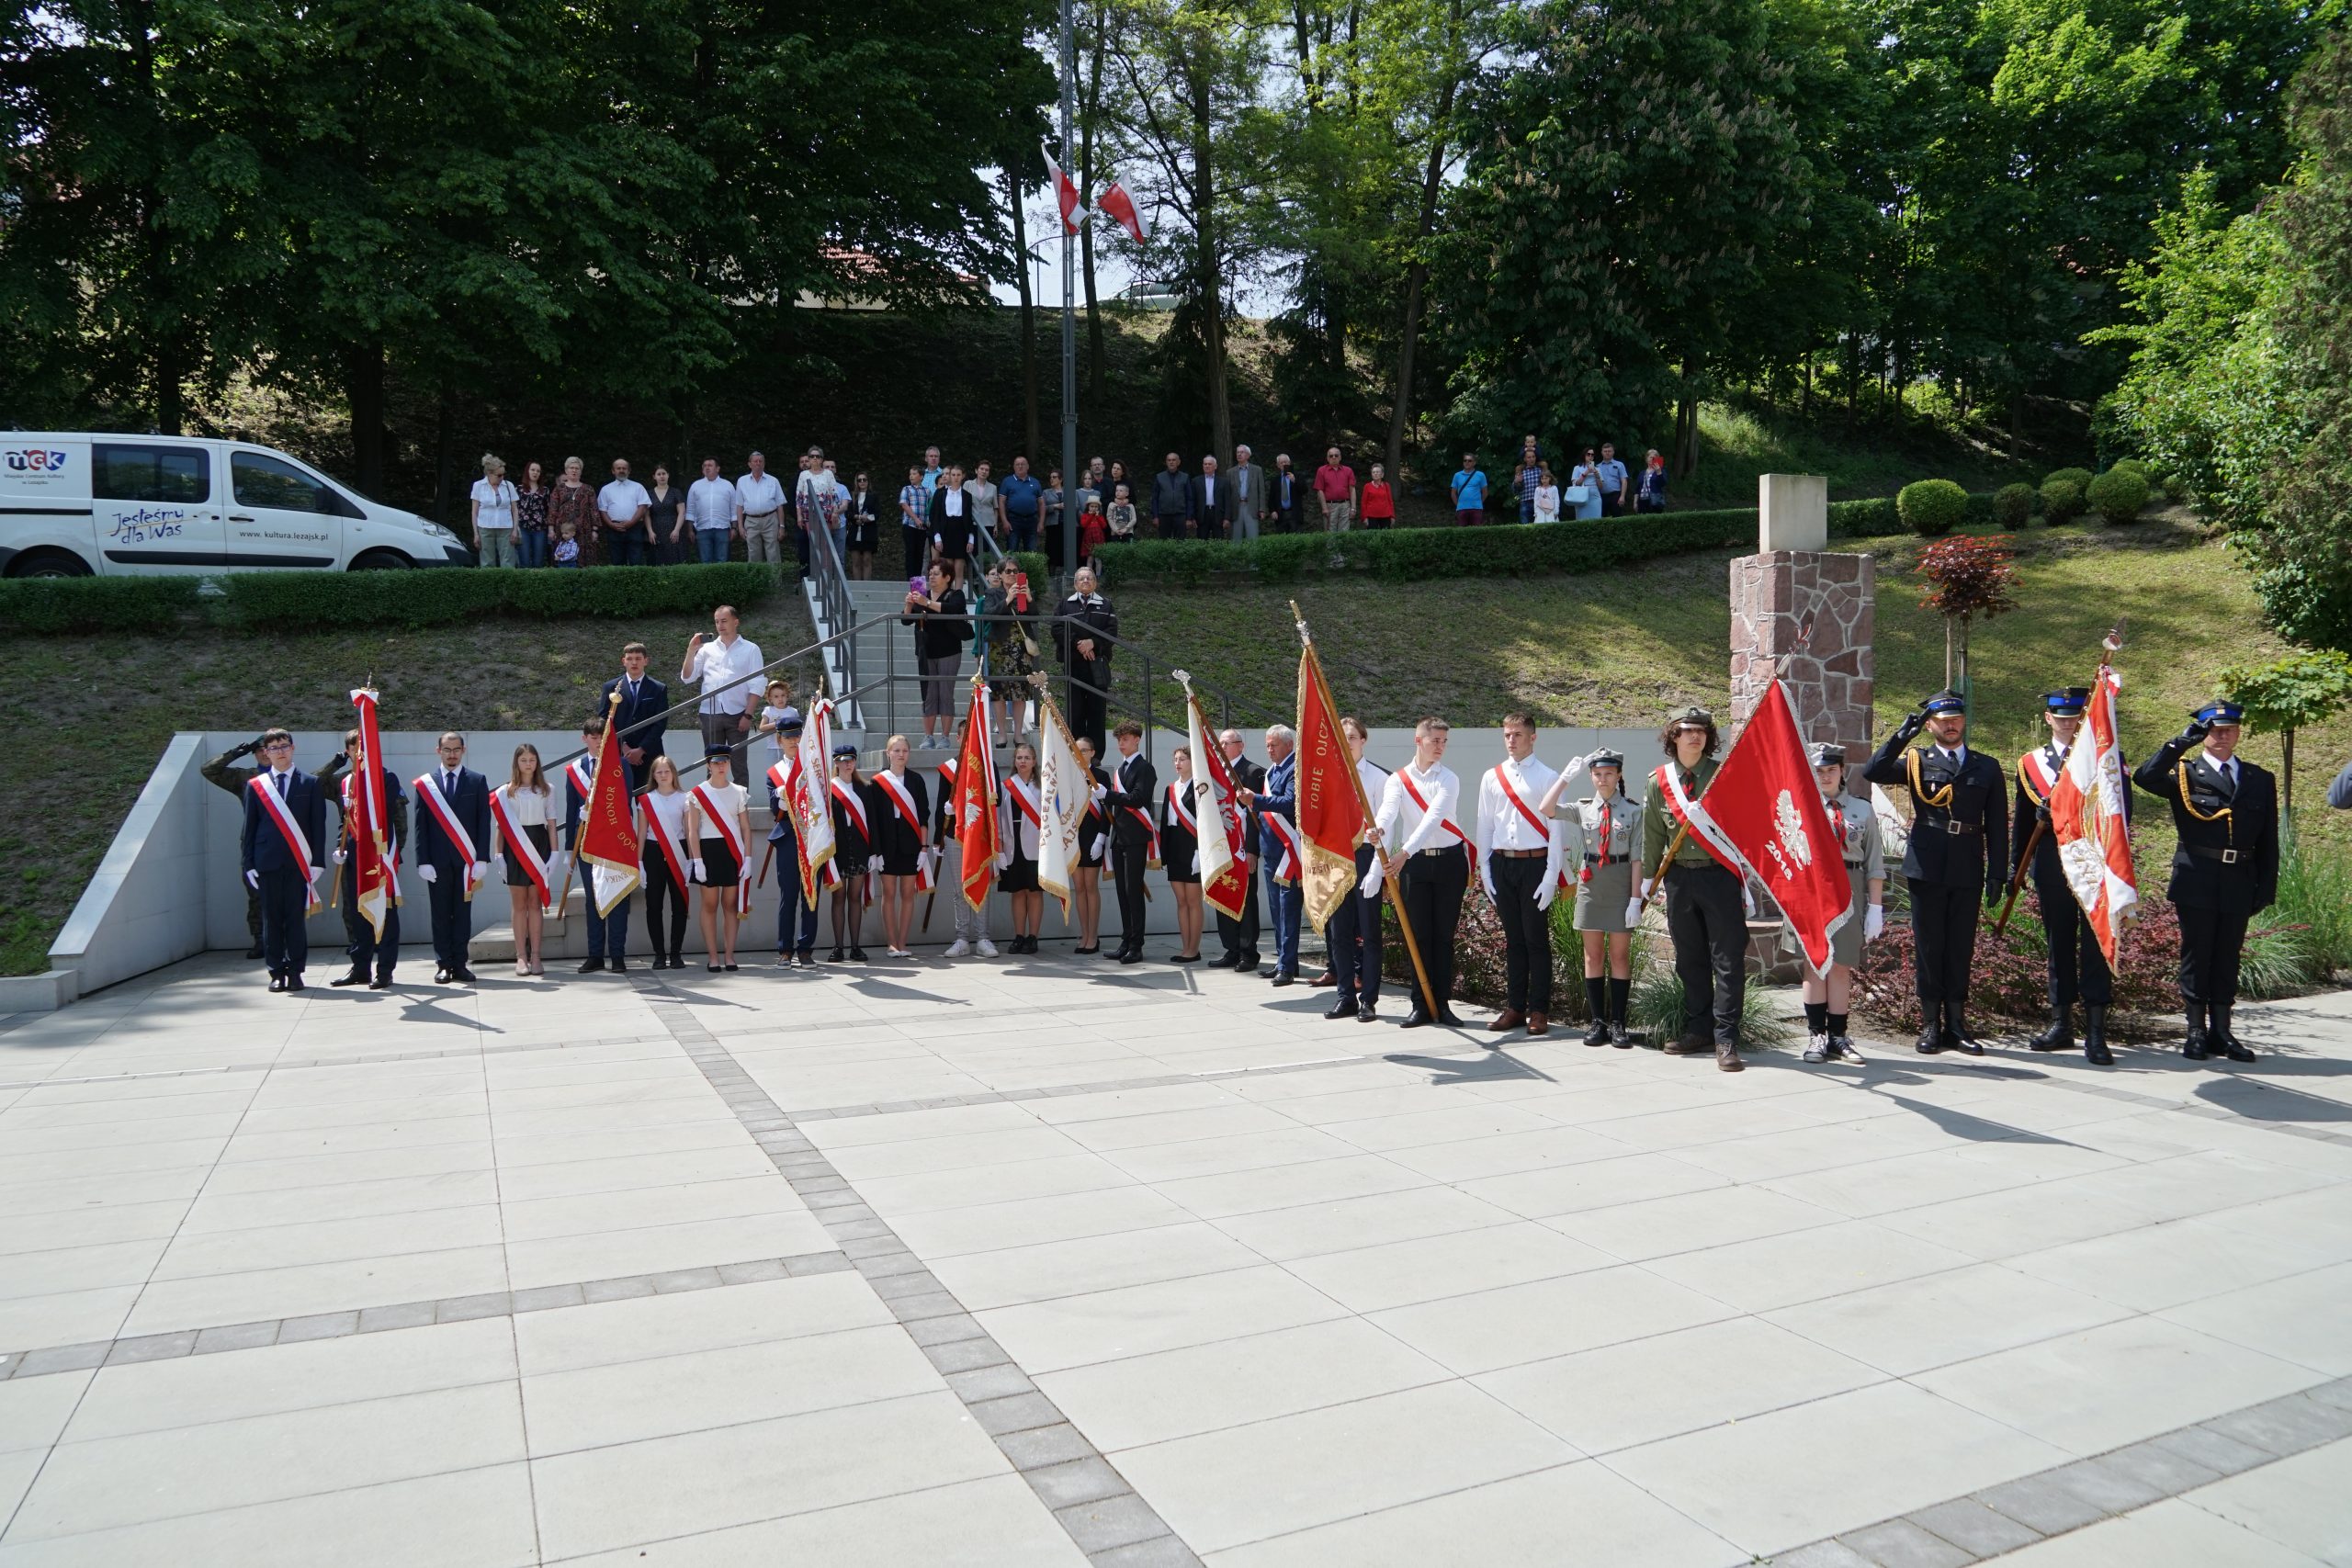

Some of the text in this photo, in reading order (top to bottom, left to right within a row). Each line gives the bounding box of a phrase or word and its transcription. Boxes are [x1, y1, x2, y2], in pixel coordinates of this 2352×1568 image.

[110, 508, 184, 536] Jesteśmy
[121, 522, 182, 546] dla Was
[1310, 766, 1324, 810] TOBIE
[605, 786, 617, 825] HONOR
